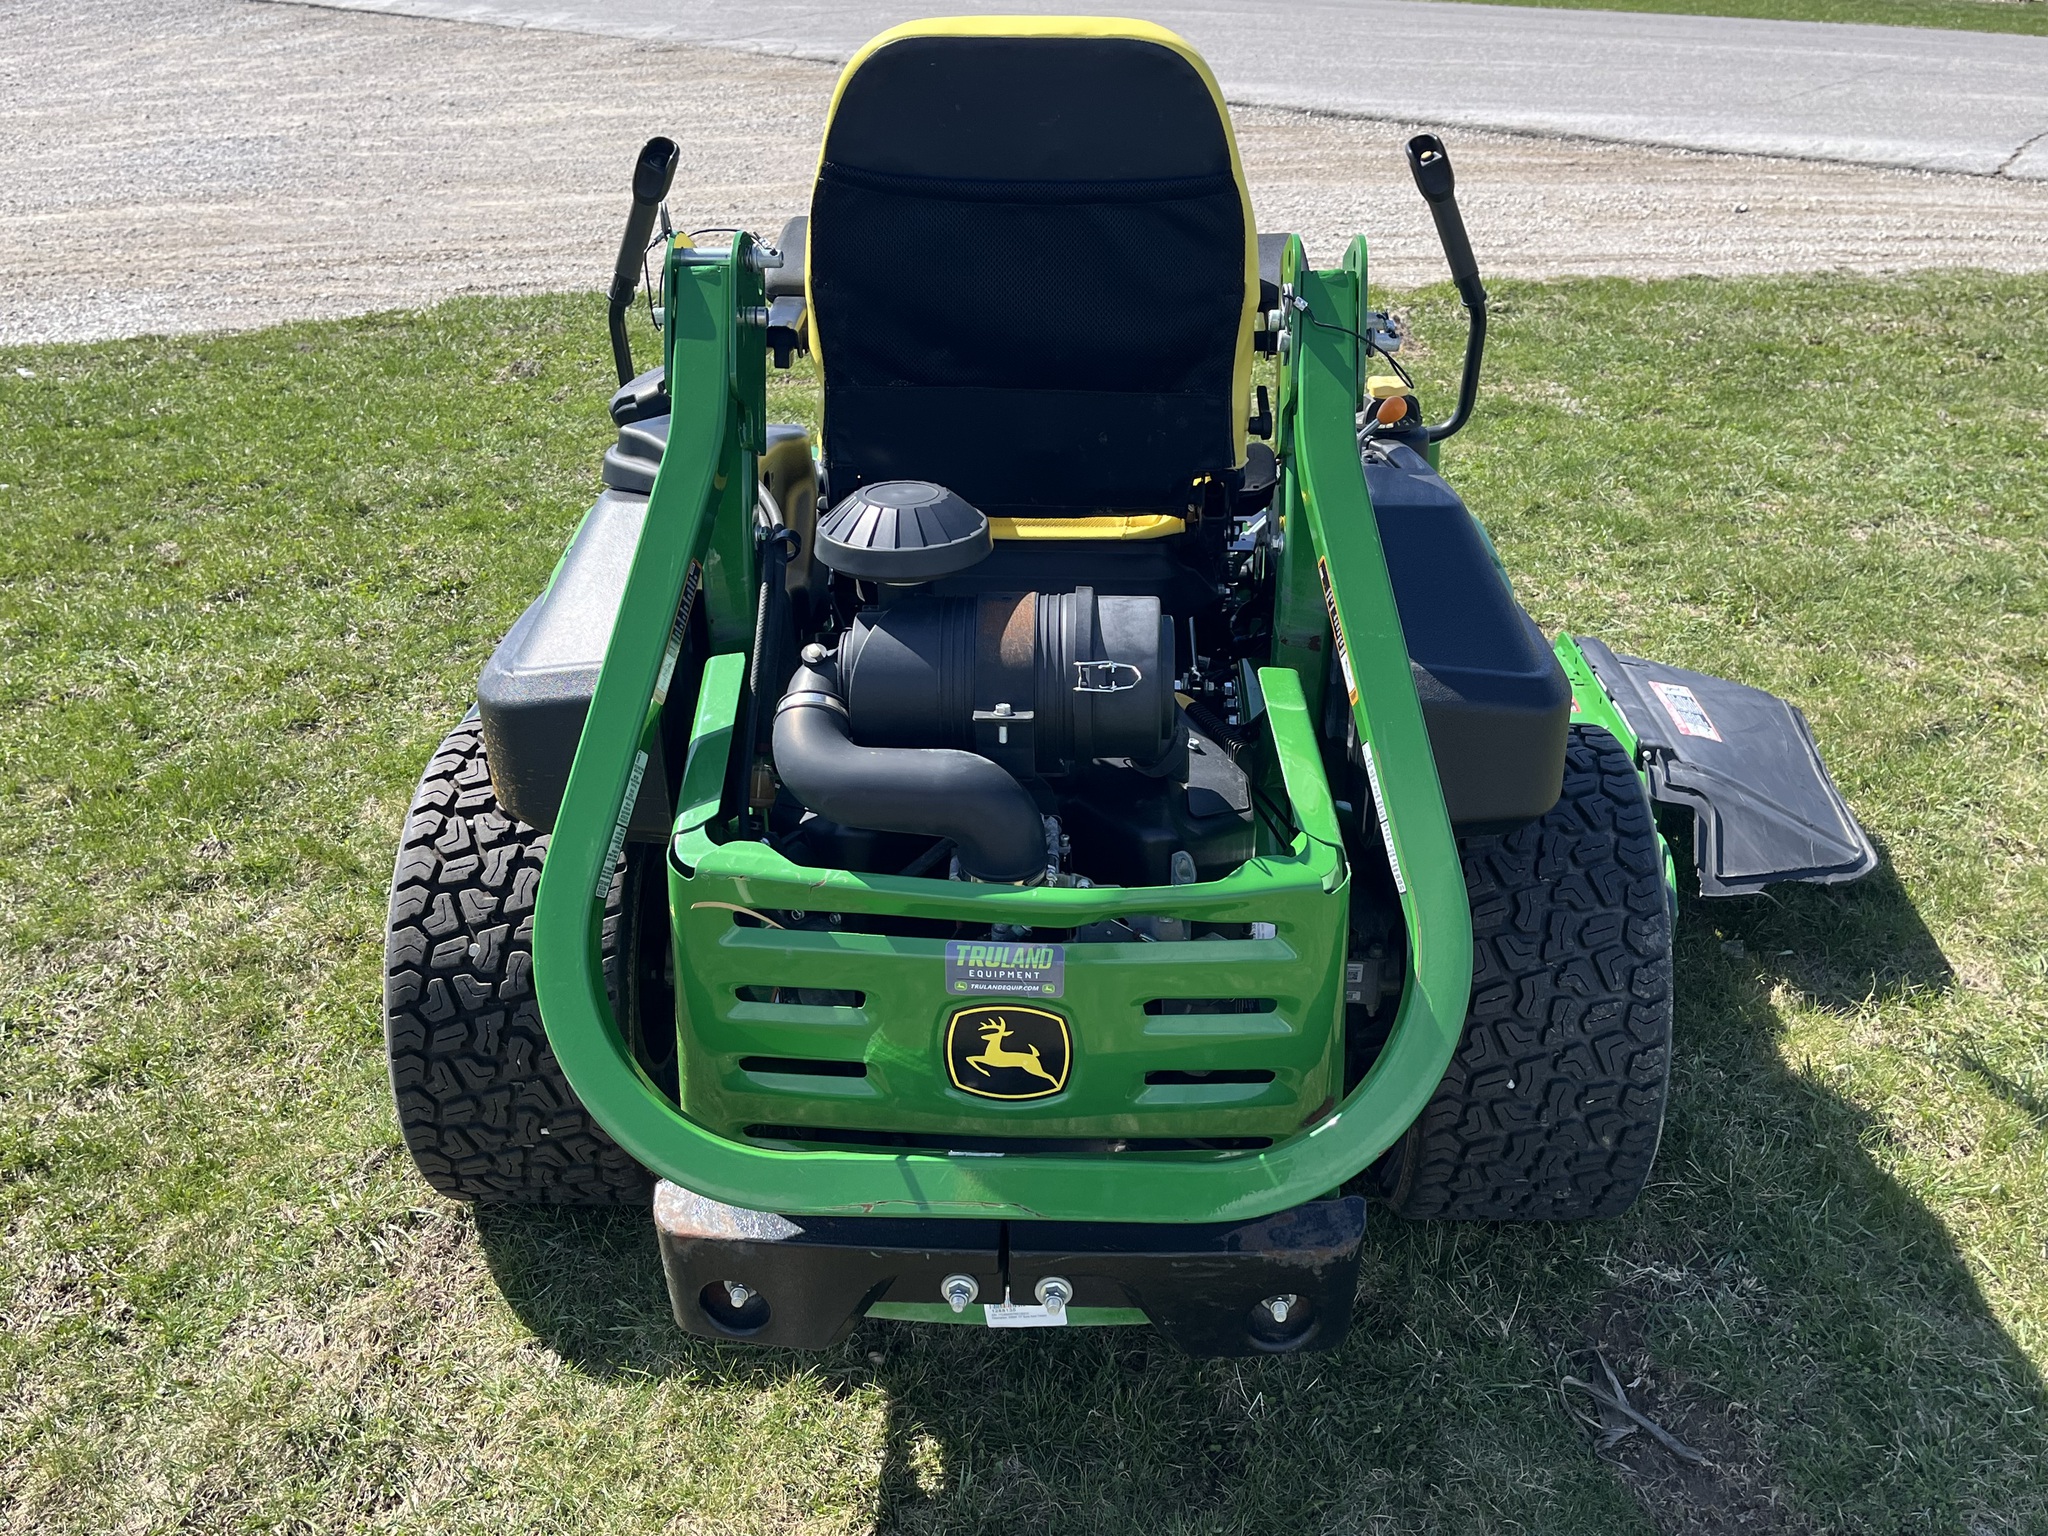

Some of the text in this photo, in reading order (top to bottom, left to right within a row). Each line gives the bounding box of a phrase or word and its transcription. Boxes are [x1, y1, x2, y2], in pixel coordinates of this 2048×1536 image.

[956, 945, 1054, 969] TRULAND
[969, 969, 1040, 979] EQUIPMENT
[970, 983, 1039, 991] TRULANDEQUIP.COM
